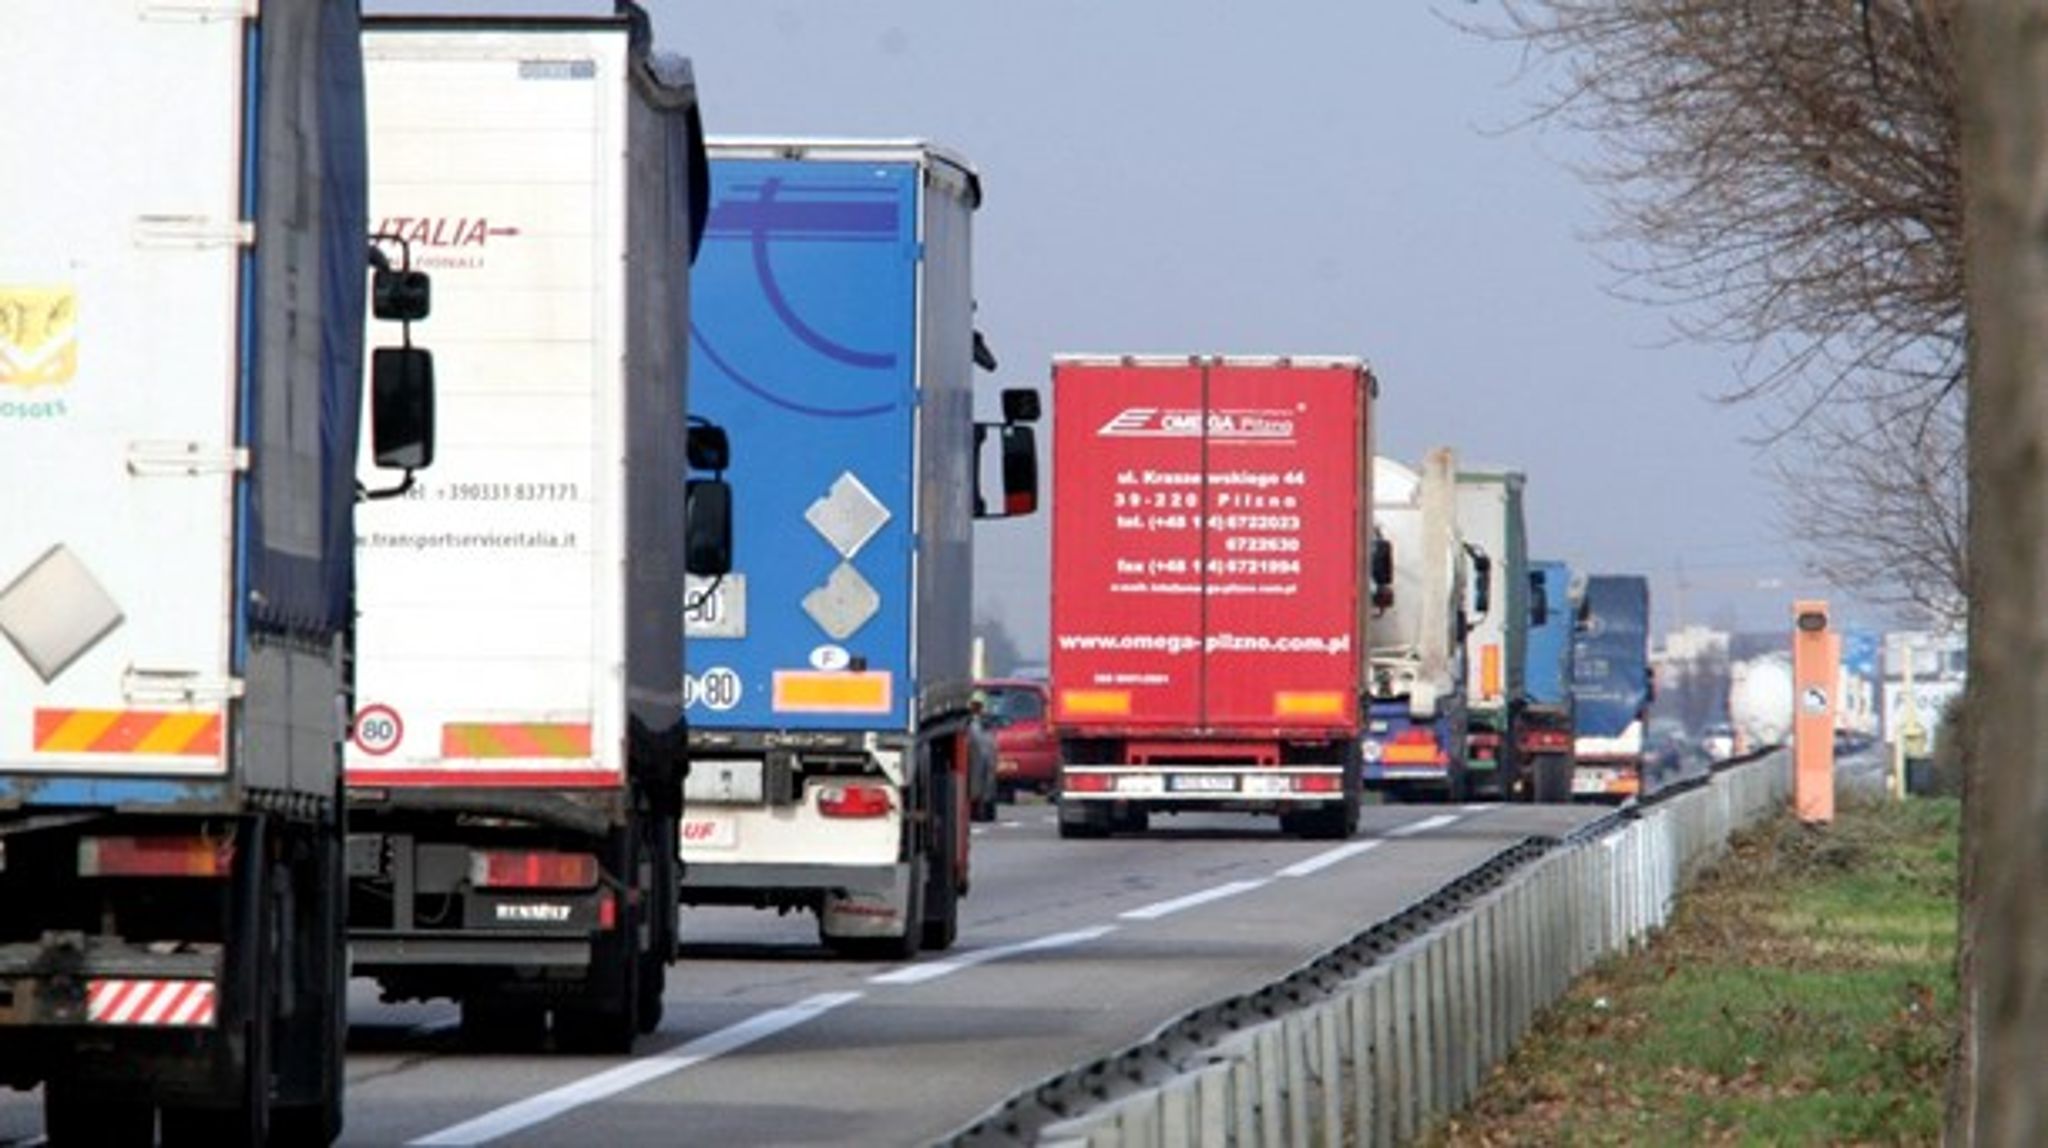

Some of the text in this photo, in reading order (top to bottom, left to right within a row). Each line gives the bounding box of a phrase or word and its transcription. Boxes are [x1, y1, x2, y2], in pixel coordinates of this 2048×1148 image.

[375, 217, 487, 247] ITALIA
[1161, 415, 1236, 433] OMEGA
[1114, 492, 1199, 508] 39-220
[1058, 633, 1350, 655] www.omega-pilzno.com.pl
[704, 673, 733, 705] 80
[361, 720, 394, 741] 80
